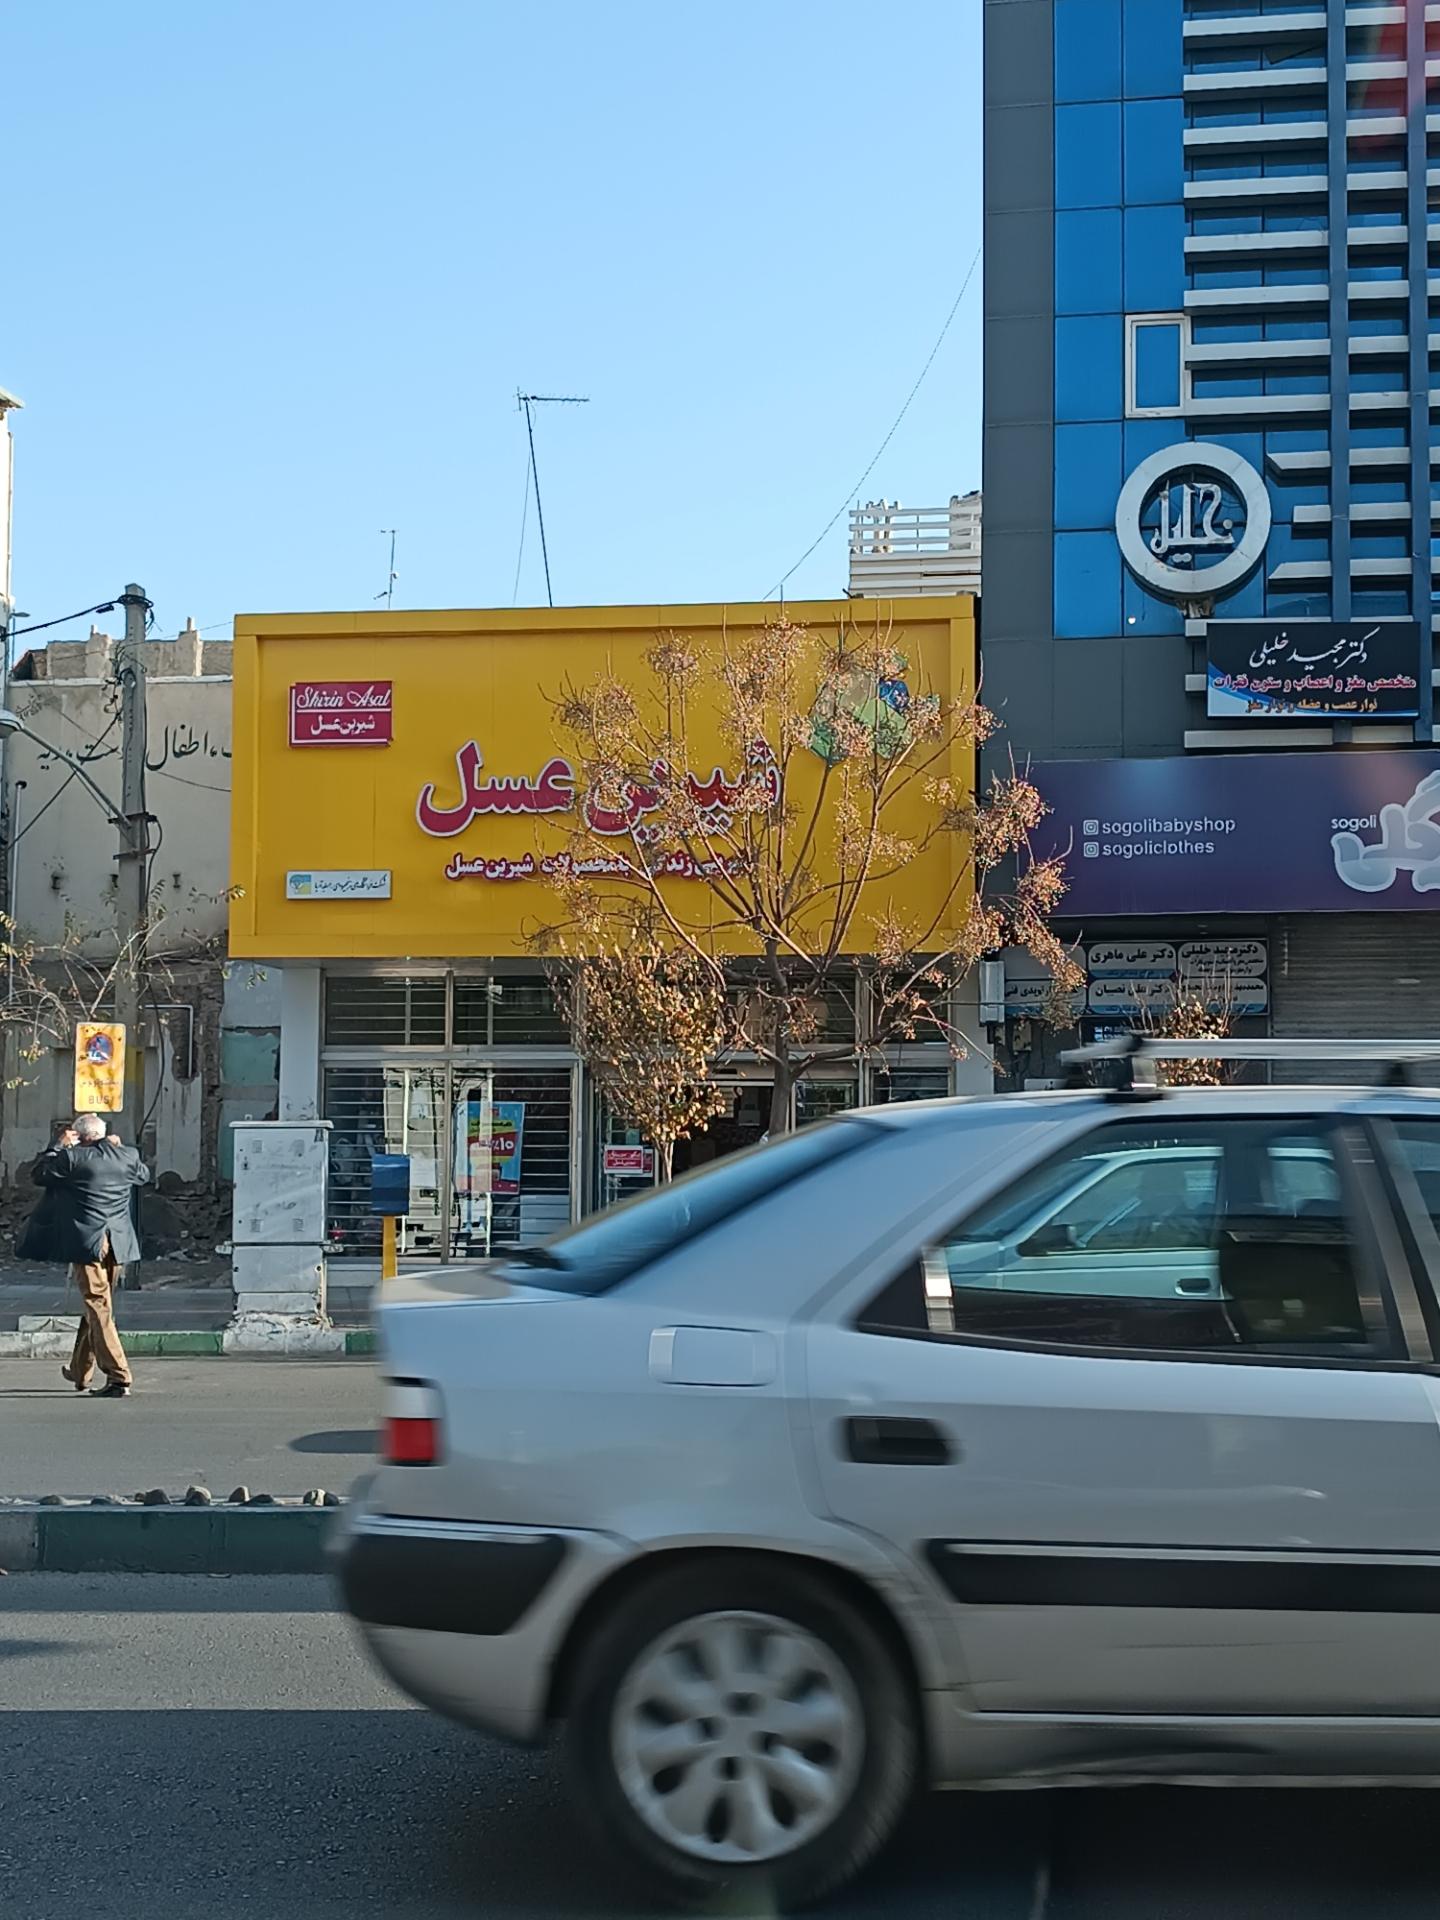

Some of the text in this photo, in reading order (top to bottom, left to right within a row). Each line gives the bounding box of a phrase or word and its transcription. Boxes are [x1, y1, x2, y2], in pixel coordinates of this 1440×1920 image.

[1249, 626, 1380, 671] دکتر مجید خلیلی
[1213, 673, 1416, 693] متخصص مغز و اعصاب و ستون فقرات
[296, 685, 392, 708] Shirin Asal
[1331, 698, 1358, 710] عصب
[1359, 698, 1378, 713] نوار
[310, 714, 376, 736] شیرین عسل
[416, 739, 576, 838] عسل
[1101, 817, 1236, 836] sogolibabyshop
[1331, 814, 1377, 832] sogoli
[1101, 840, 1215, 859] sogoliclothes
[444, 851, 485, 881] عسل
[483, 851, 536, 880] شیرین
[1127, 948, 1148, 963] علی
[1150, 947, 1175, 963] دکتر
